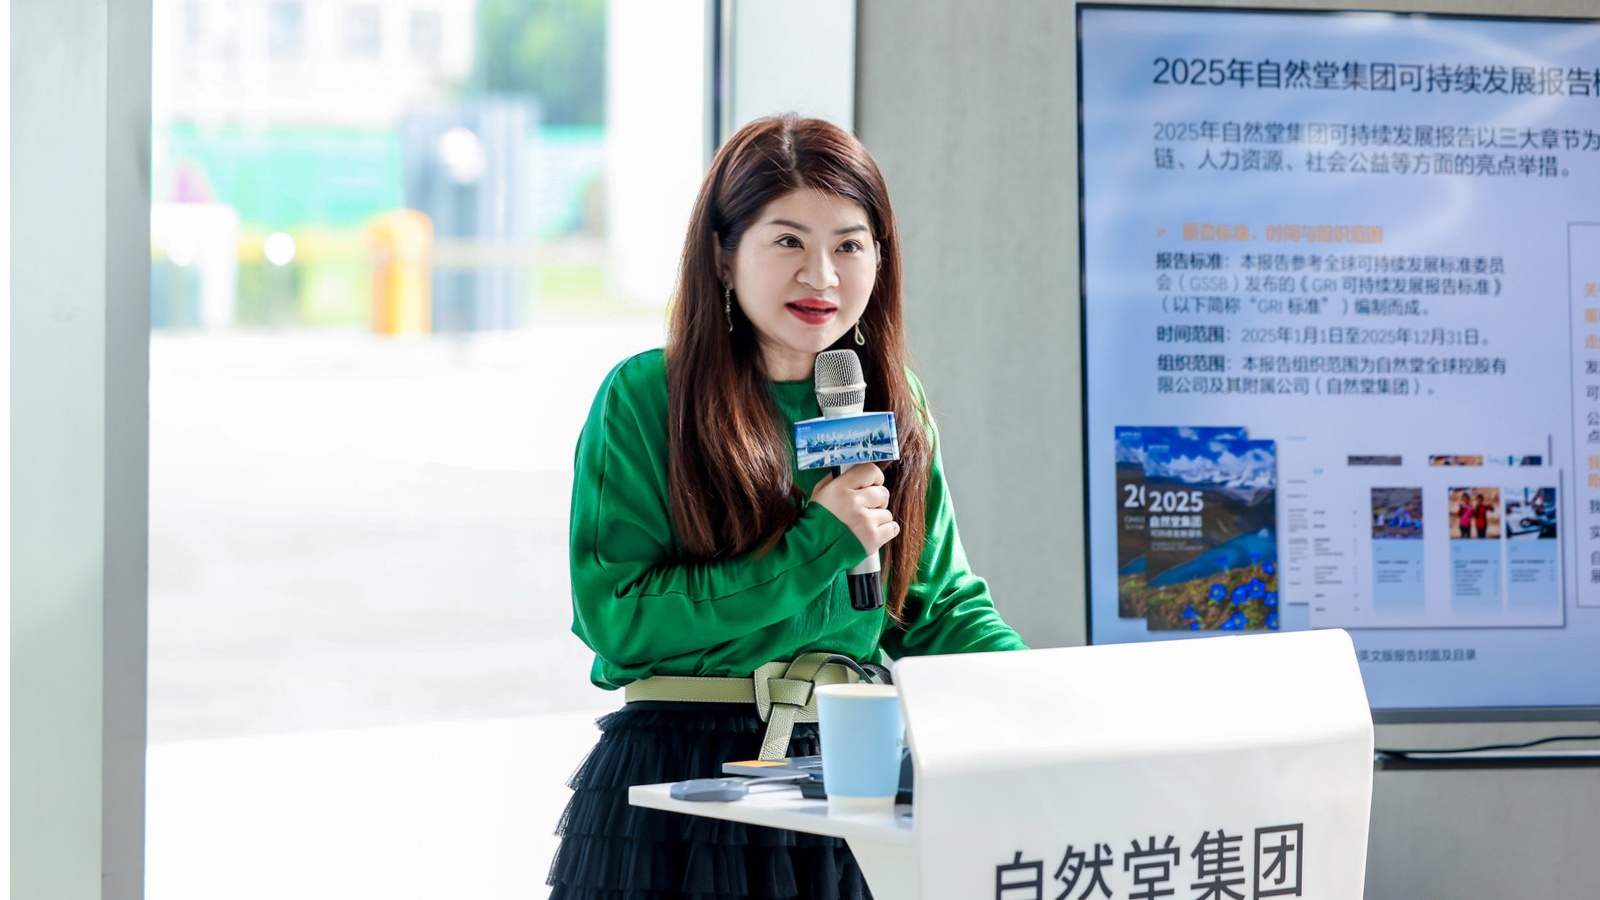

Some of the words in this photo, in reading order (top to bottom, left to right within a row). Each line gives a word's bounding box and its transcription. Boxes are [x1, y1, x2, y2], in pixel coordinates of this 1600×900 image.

[1153, 121, 1600, 151] 2025年自然堂集团可持续发展报告以三大章节为
[1154, 147, 1569, 178] 链、人力资源、社会公益等方面的亮点举措。
[1182, 223, 1384, 244] 报告标准、时间与组织范围
[1149, 490, 1204, 512] 2025
[1150, 515, 1202, 528] 自然堂集团
[996, 822, 1304, 900] 自然堂集团
